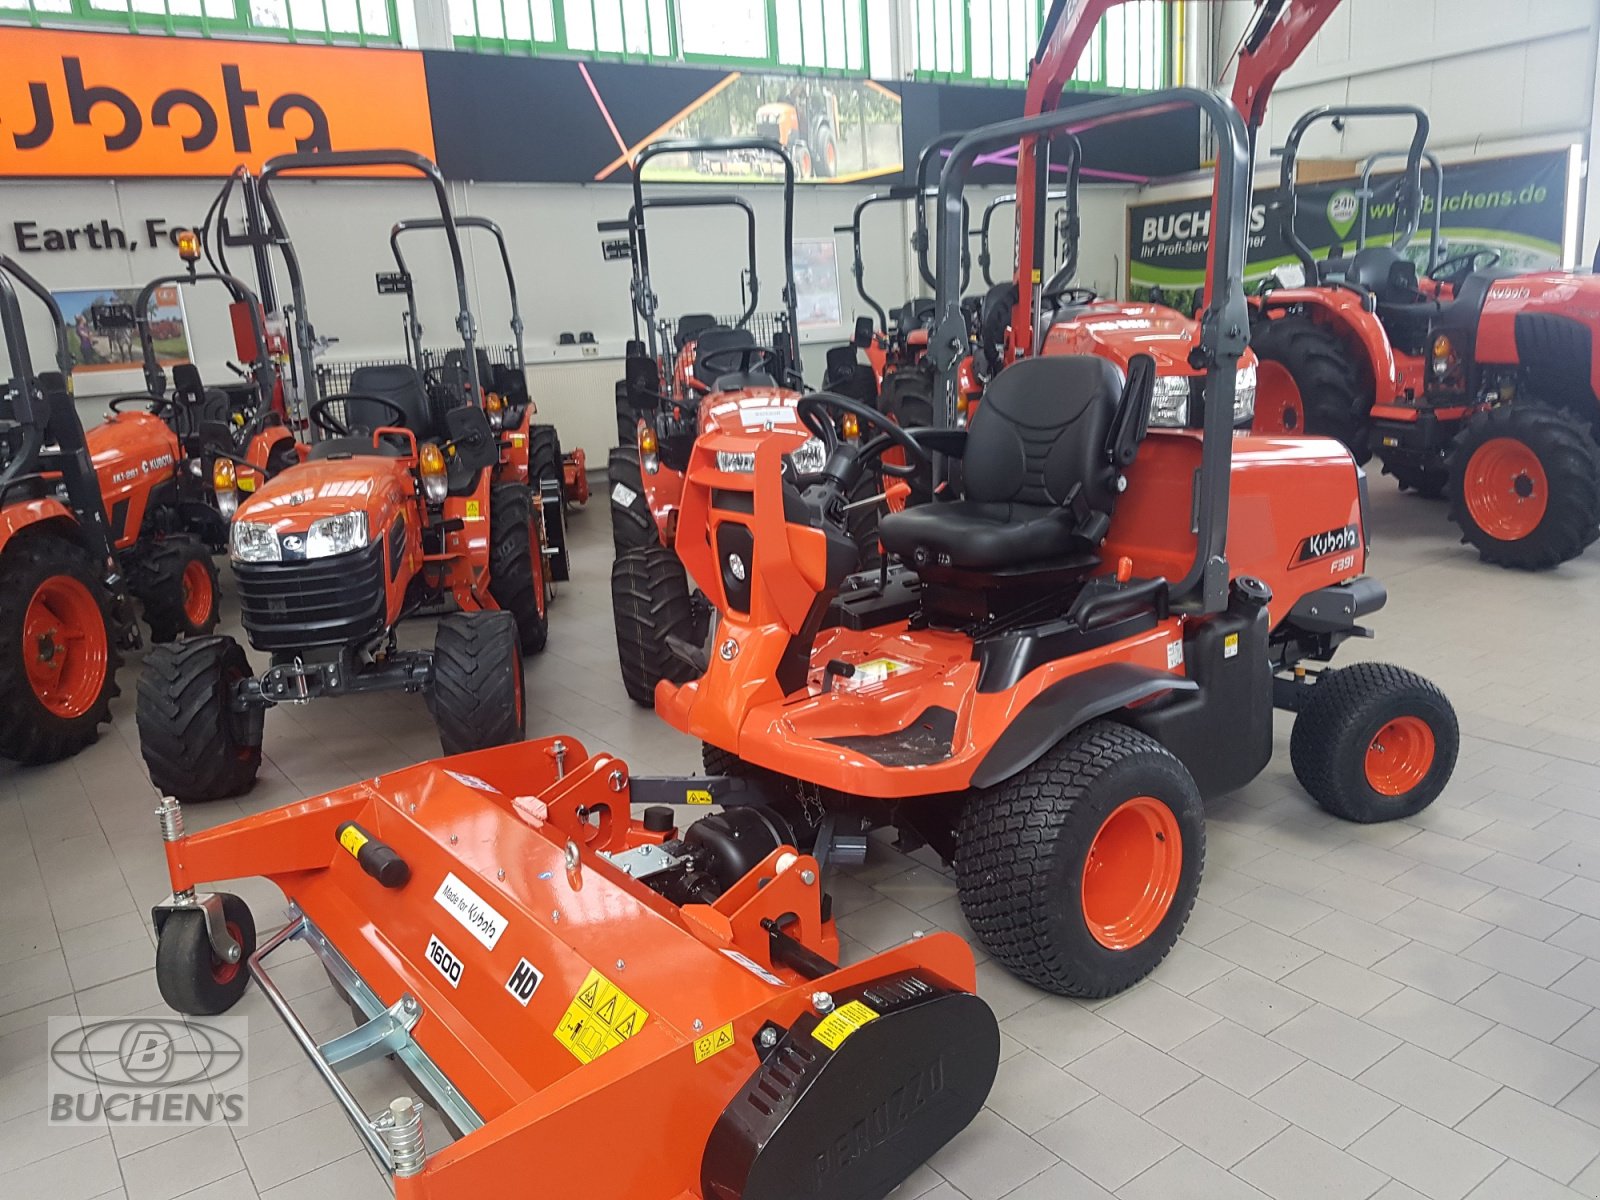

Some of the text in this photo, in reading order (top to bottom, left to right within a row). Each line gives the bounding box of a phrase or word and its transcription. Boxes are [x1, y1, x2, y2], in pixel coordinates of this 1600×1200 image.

[0, 56, 333, 153] ubota
[13, 219, 138, 252] Earth,
[1142, 204, 1266, 242] BUCHS
[1141, 245, 1154, 258] Ihr
[149, 453, 172, 470] KUBOTA
[1310, 526, 1356, 557] Kubota
[1330, 555, 1354, 575] F391
[442, 885, 496, 939] Made for Kubota
[430, 941, 461, 982] 1600
[508, 961, 539, 1000] HD
